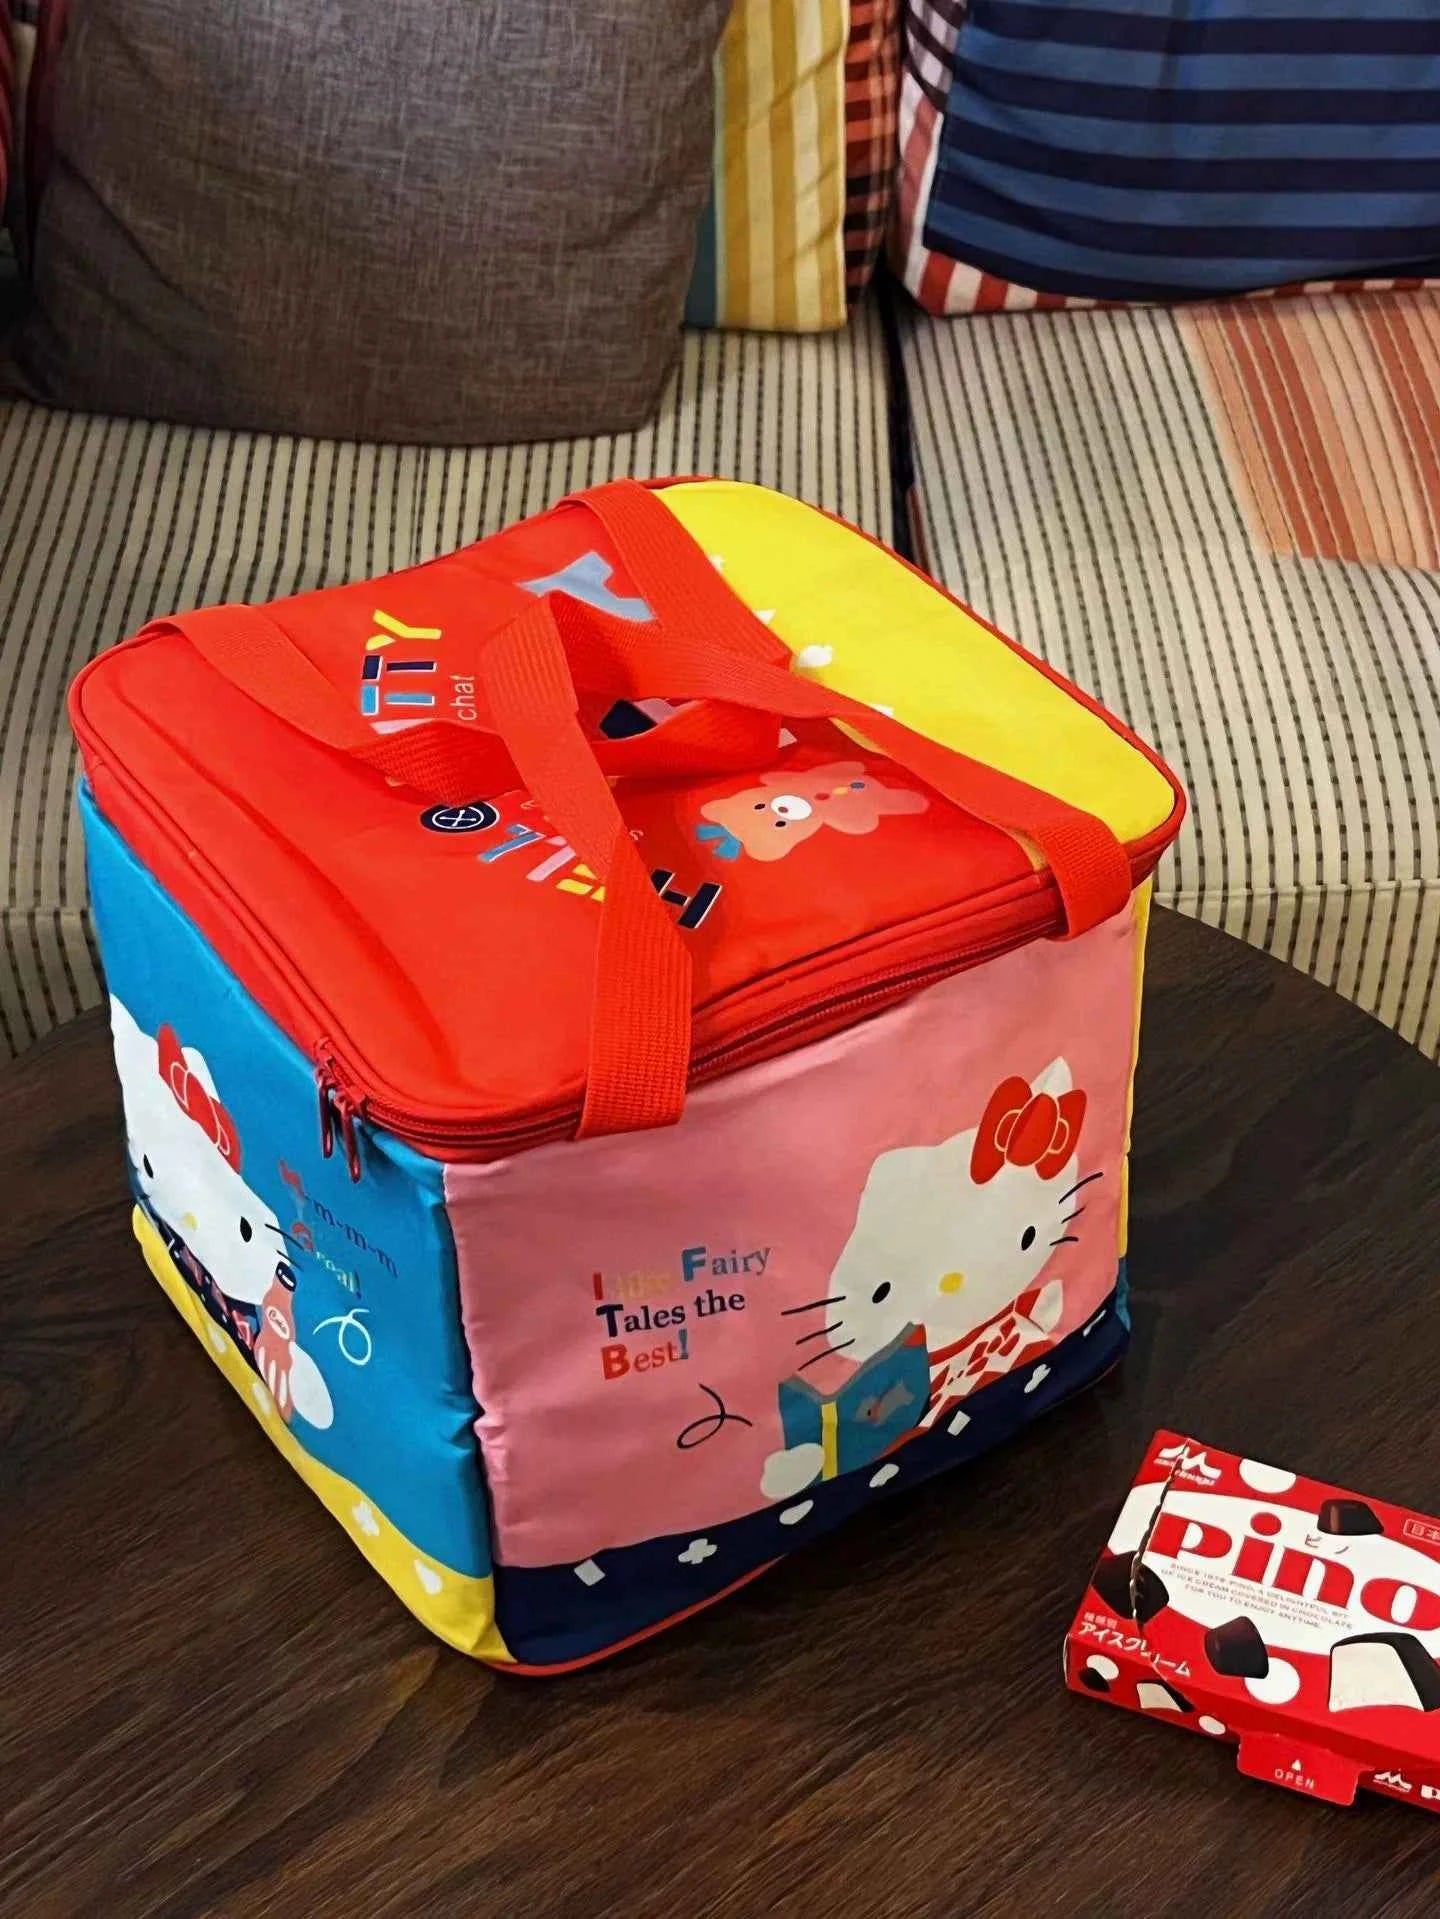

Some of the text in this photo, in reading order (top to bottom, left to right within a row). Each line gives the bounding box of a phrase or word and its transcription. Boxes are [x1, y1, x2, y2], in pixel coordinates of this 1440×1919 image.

[592, 1272, 604, 1301] I
[681, 1246, 771, 1282] Fairy
[595, 1289, 746, 1338] Tales the
[601, 1328, 689, 1381] Best!
[1147, 1511, 1440, 1632] pino
[1274, 1768, 1316, 1790] OPEN
